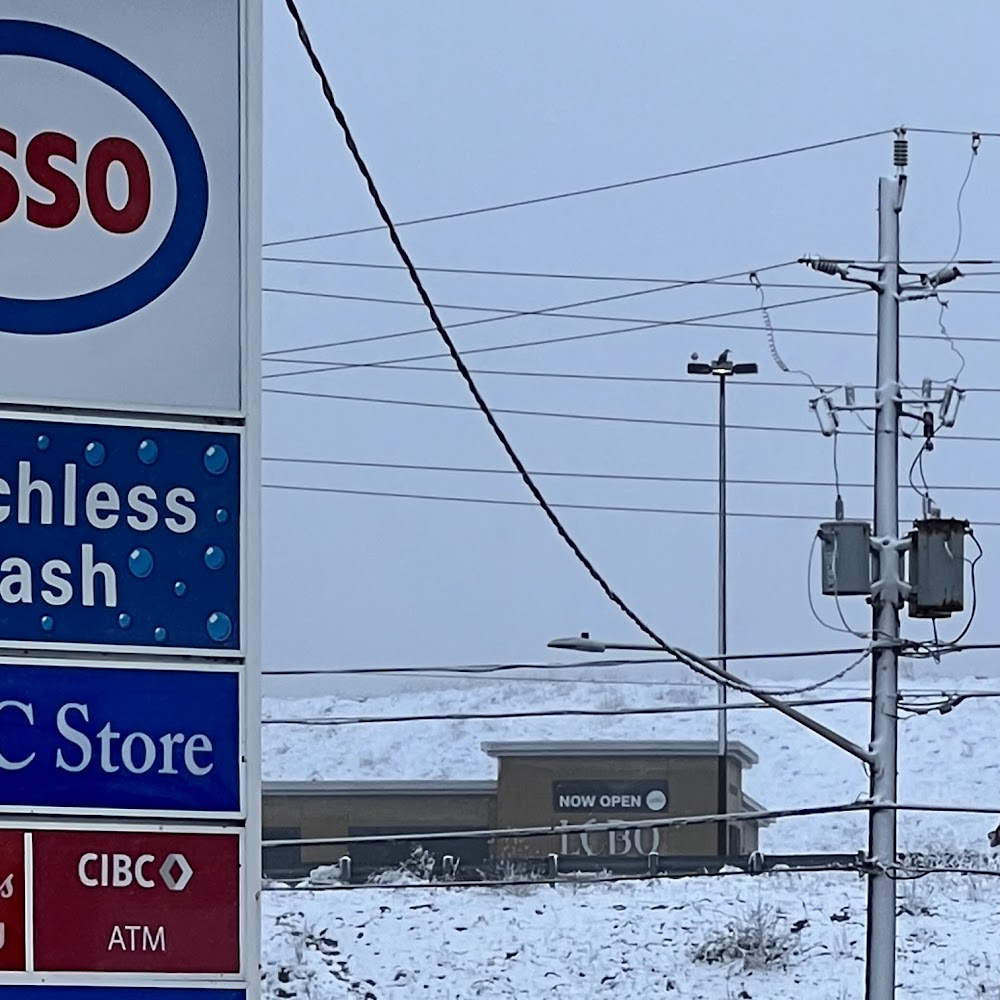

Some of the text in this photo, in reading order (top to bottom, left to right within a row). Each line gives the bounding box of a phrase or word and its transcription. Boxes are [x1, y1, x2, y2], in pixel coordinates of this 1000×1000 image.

[0, 543, 118, 608] ash
[56, 702, 214, 776] Store
[559, 794, 596, 808] NOW
[599, 794, 642, 808] OPEN
[78, 852, 156, 888] CIBC
[108, 925, 166, 952] ATM
